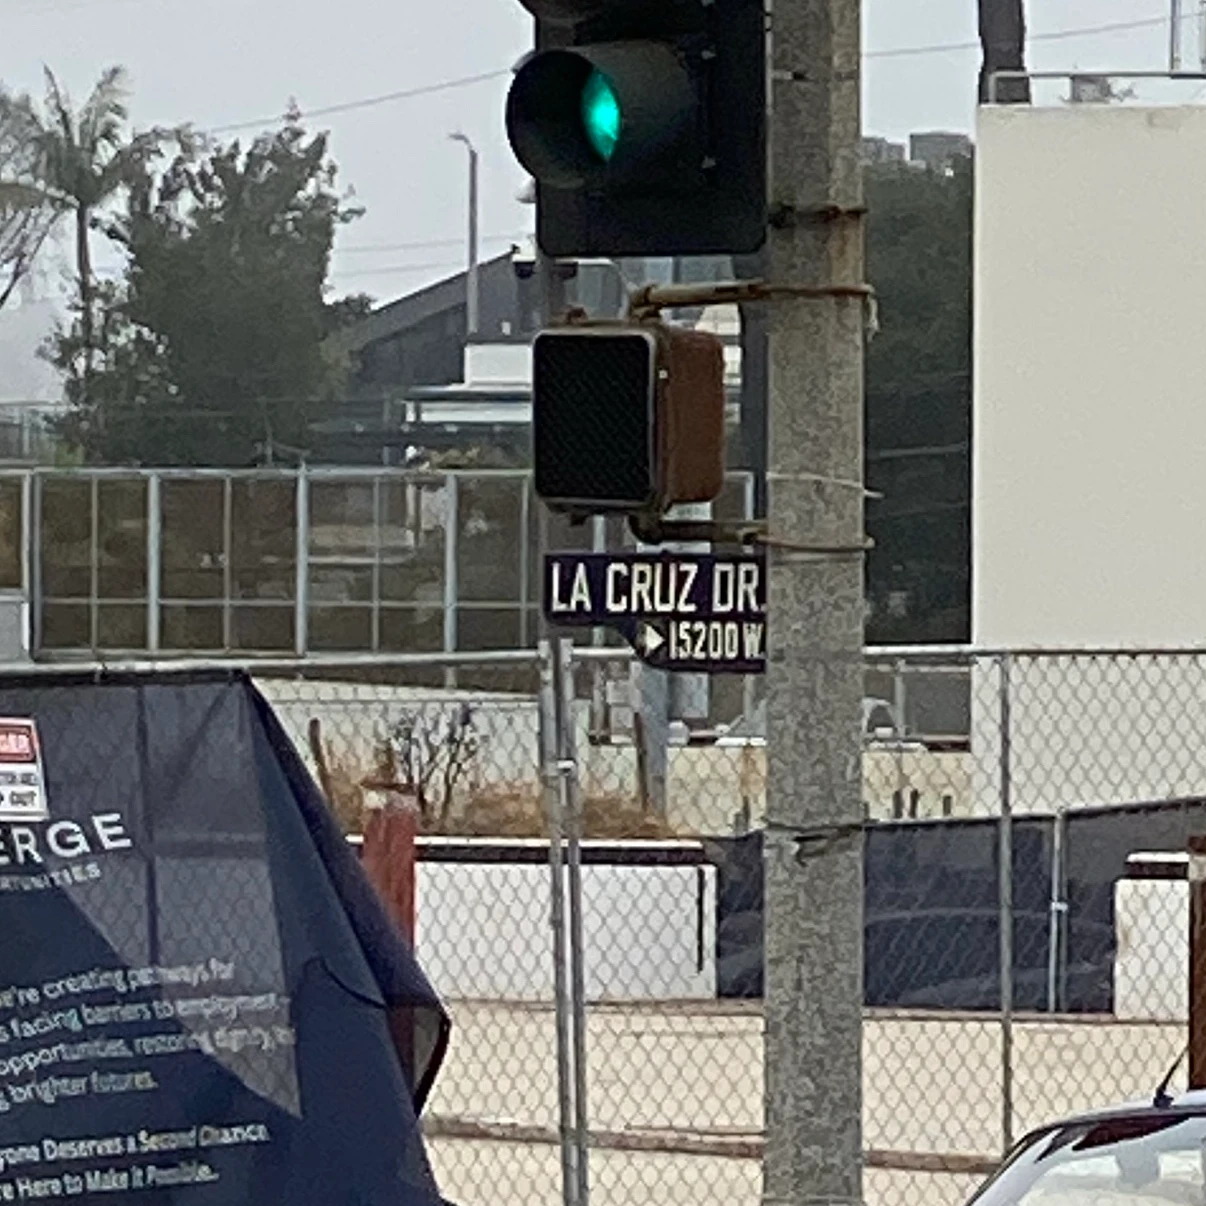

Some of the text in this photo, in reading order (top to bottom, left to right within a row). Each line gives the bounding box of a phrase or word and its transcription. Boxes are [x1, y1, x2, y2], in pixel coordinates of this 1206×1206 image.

[552, 562, 592, 612] LA
[605, 562, 697, 612] CRUZ
[669, 620, 738, 660] 15200
[43, 968, 127, 999] creating
[10, 1008, 83, 1040] facing
[8, 1076, 87, 1104] brighter
